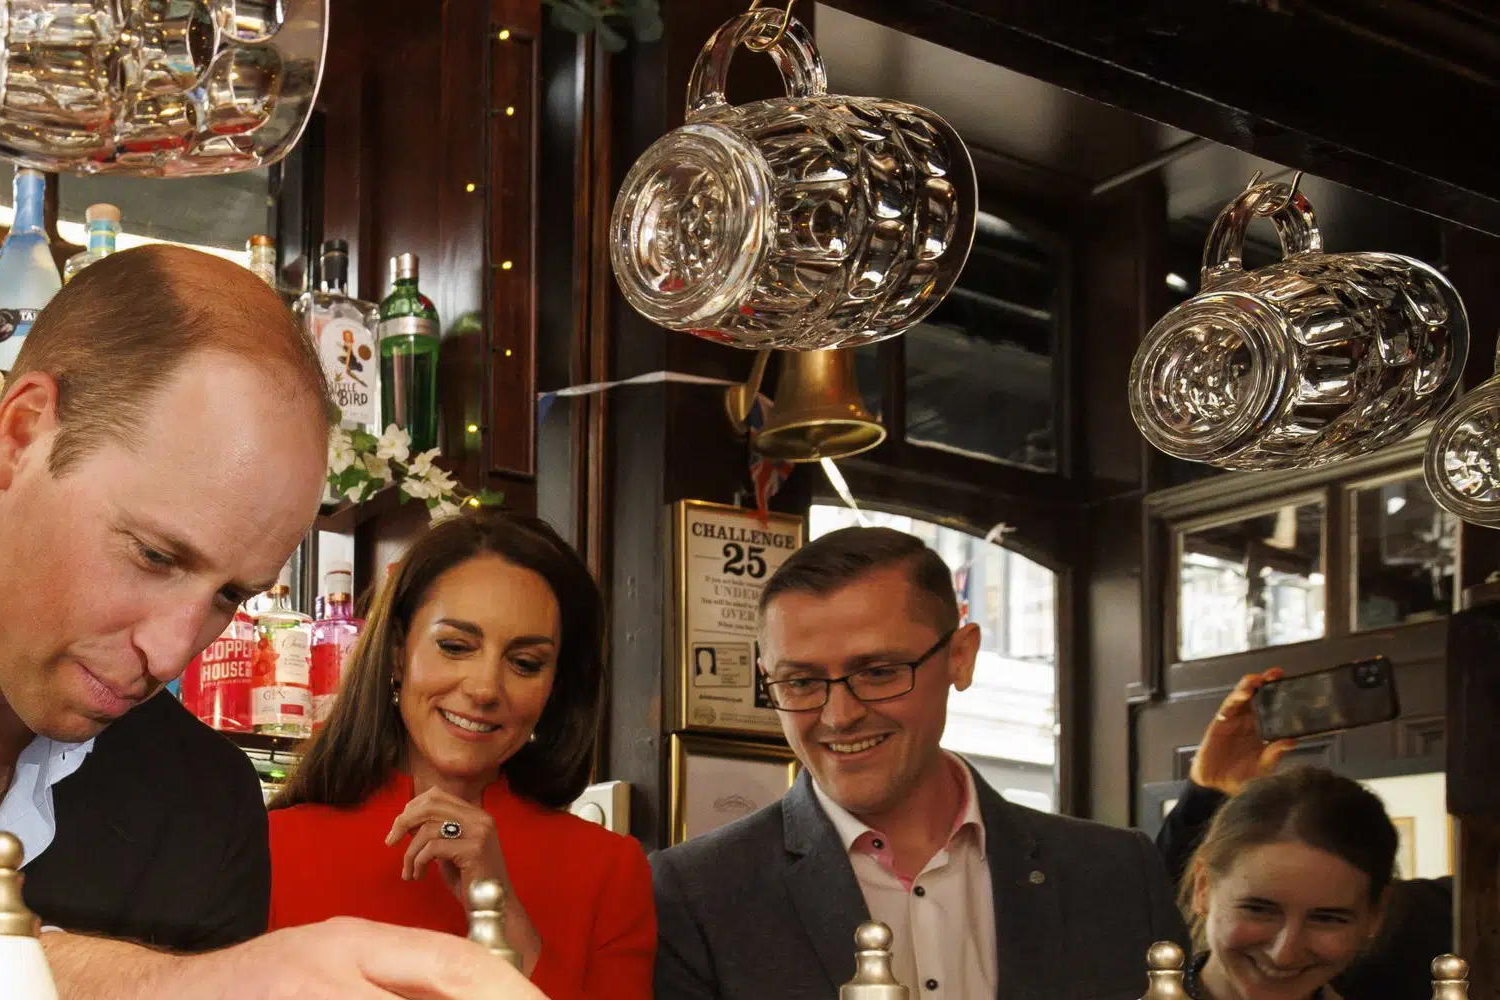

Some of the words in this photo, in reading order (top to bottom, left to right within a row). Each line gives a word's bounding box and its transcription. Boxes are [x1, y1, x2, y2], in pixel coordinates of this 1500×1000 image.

[338, 389, 368, 406] BIRD
[692, 522, 796, 549] CHALLENGE
[723, 542, 767, 578] 25
[714, 584, 759, 600] UNDER
[721, 607, 755, 621] OVER
[201, 661, 245, 682] HOUSE
[263, 687, 286, 700] GIN
